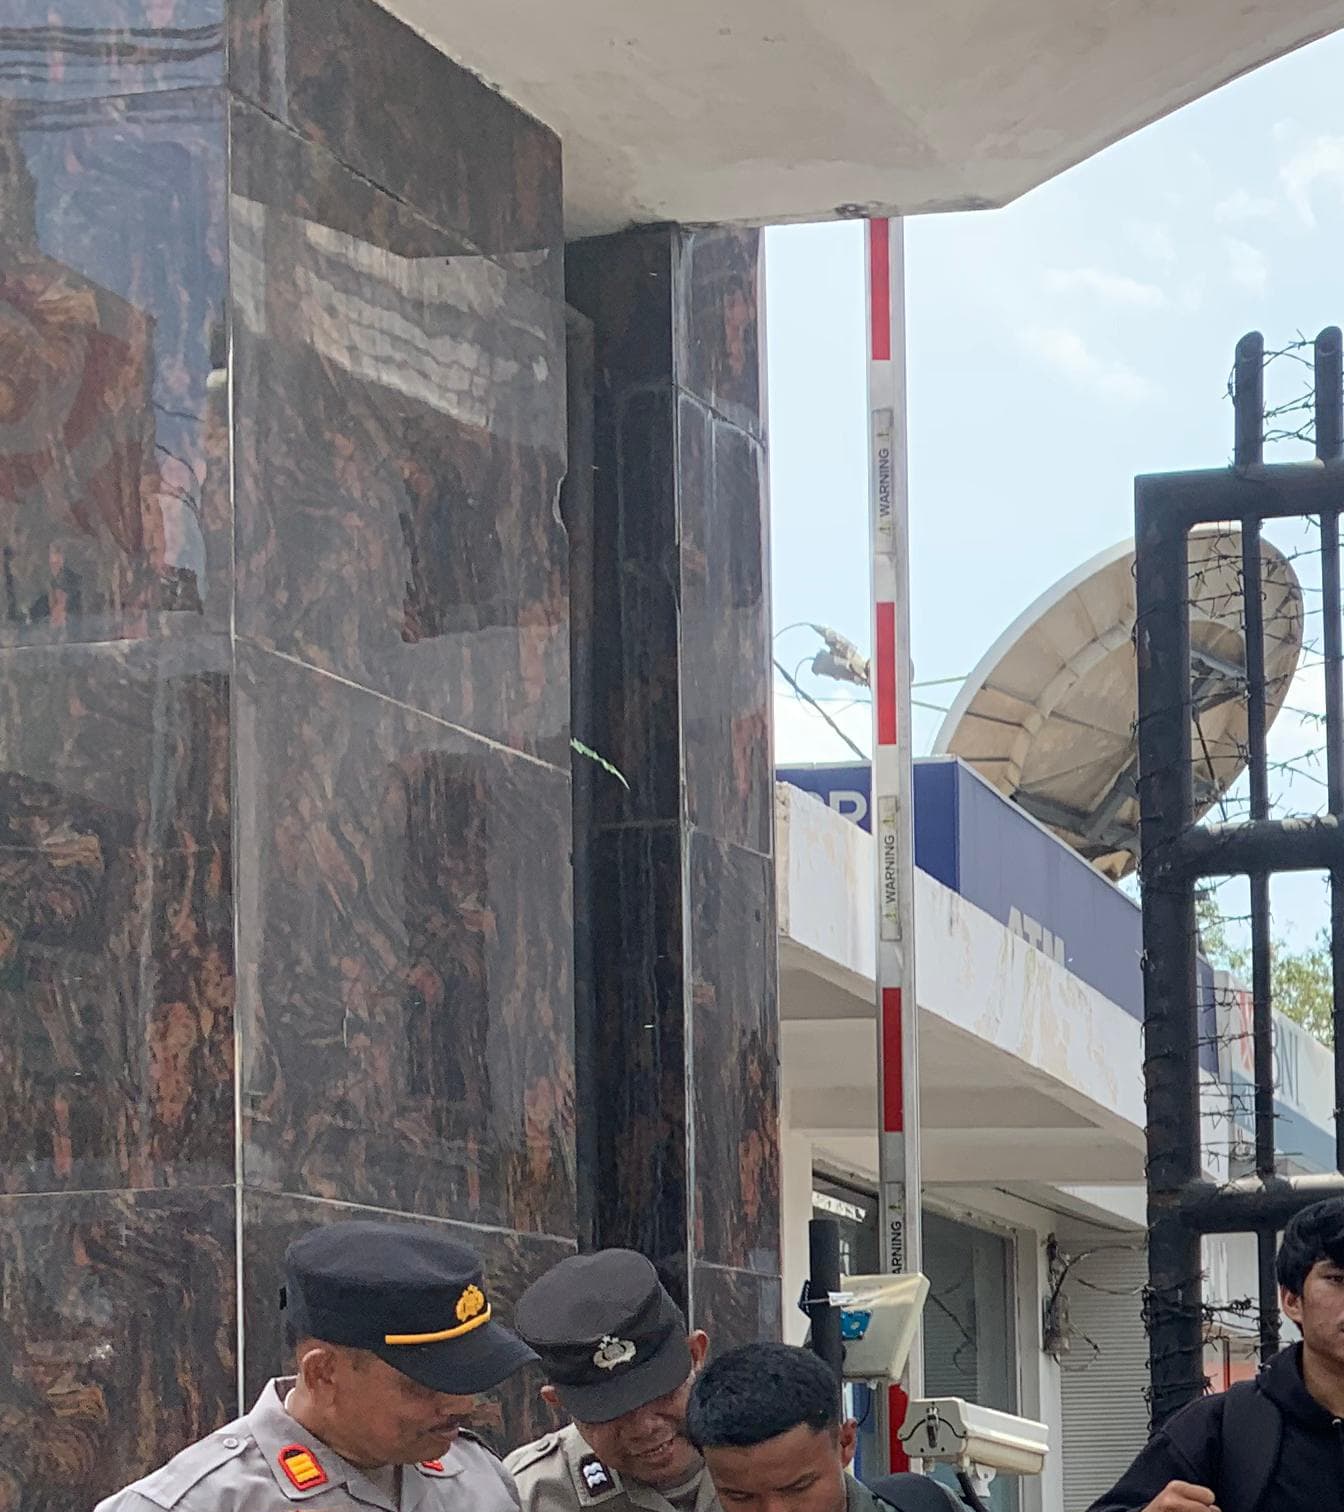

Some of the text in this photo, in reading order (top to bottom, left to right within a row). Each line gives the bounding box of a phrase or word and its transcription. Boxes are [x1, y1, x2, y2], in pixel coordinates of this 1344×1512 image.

[878, 447, 891, 518] WARNING
[883, 834, 896, 904] WARNING
[891, 1220, 903, 1274] ARNING
